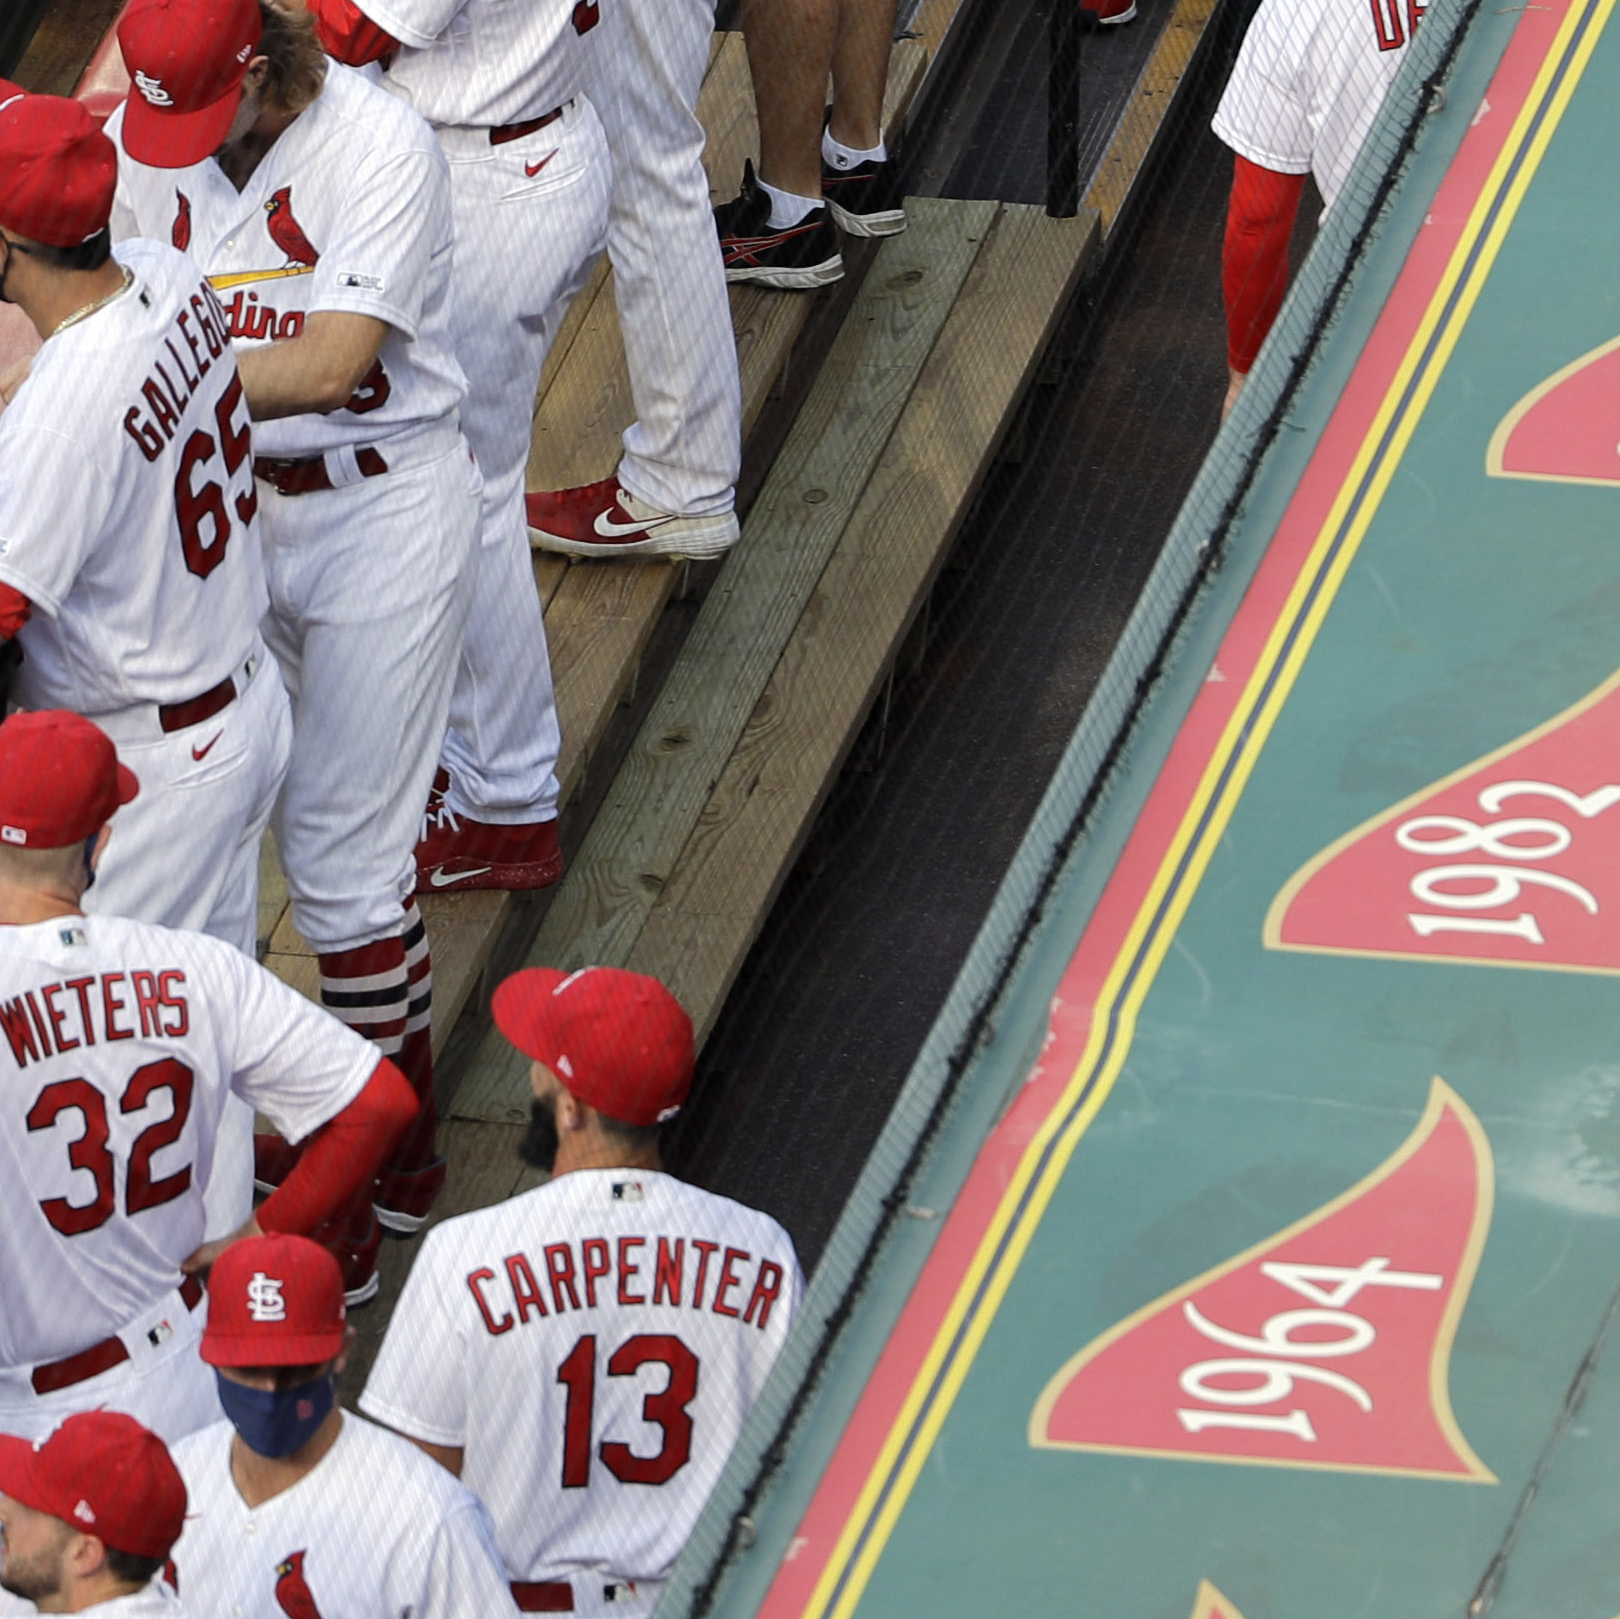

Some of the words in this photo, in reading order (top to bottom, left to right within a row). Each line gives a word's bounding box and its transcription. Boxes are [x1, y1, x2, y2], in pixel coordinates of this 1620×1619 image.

[174, 367, 258, 580] 65
[26, 1056, 194, 1237] 32
[467, 1237, 783, 1335] CARPENTER
[1177, 1257, 1443, 1442] 1964
[557, 1334, 699, 1489] 13
